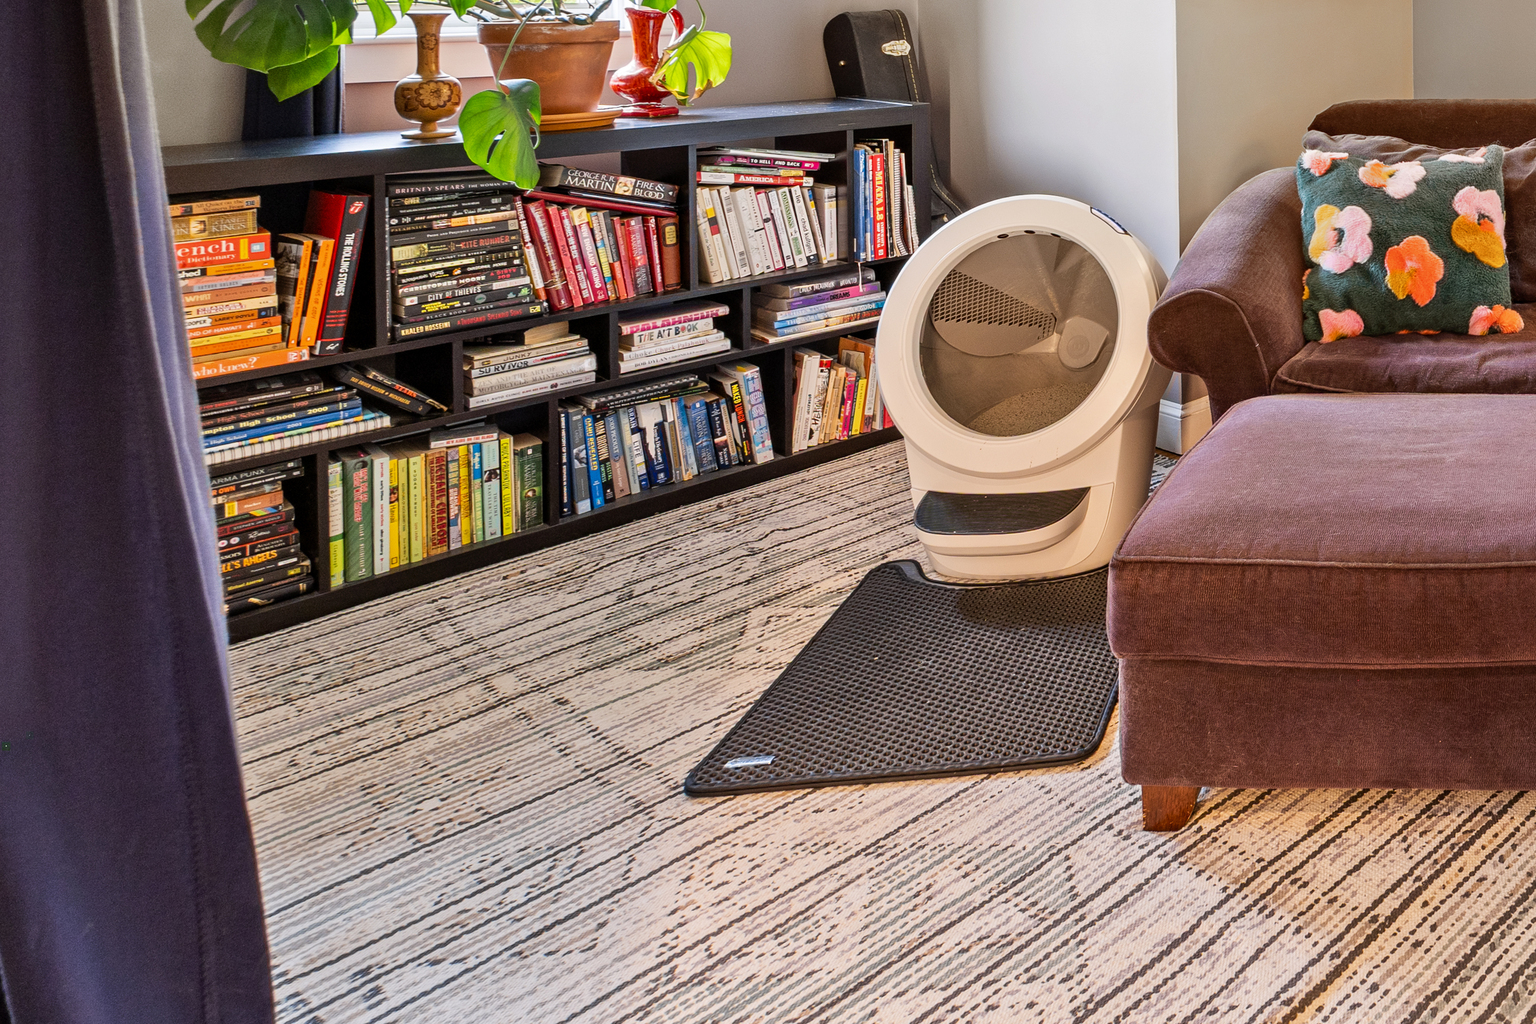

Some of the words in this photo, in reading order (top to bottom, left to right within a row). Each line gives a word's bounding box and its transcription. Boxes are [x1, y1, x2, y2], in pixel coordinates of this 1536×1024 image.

[567, 169, 603, 180] GEORGE
[738, 175, 774, 183] AMERICA
[395, 186, 433, 194] BRITNEY
[565, 176, 614, 191] MARTIN
[635, 180, 654, 190] FIRE
[655, 183, 665, 192] &
[875, 171, 883, 206] MIATA
[634, 188, 664, 200] BLOOD
[515, 201, 526, 221] EXTREME
[781, 191, 795, 229] ADMISSIONS
[520, 220, 531, 243] BREWING
[562, 218, 574, 237] MICHAEL
[579, 224, 589, 238] NEW
[800, 217, 809, 233] chad
[344, 232, 355, 247] THE
[461, 240, 479, 248] KITE
[479, 235, 511, 246] RUNNER
[630, 234, 639, 257] MARTIN
[803, 232, 814, 255] kultgen
[175, 239, 235, 259] ench
[543, 242, 554, 257] CODE
[560, 244, 568, 258] PULP
[569, 244, 580, 259] BLACK
[583, 238, 596, 266] ENGLAND
[187, 251, 236, 265] Dictionary
[339, 245, 352, 273] ROLLING
[548, 259, 557, 271] DAN
[575, 263, 583, 272] MY
[334, 272, 347, 298] STONES
[402, 280, 458, 293] CHRISTOPHER
[459, 276, 486, 284] MOORE
[577, 271, 588, 290] CUSTOM
[590, 266, 603, 289] HIKING
[315, 277, 324, 297] VISIONS
[427, 292, 443, 301] CITY
[454, 286, 482, 296] THIEVES
[581, 289, 590, 298] VAN
[184, 293, 212, 303] WHAT
[829, 291, 851, 301] DREAMS
[400, 326, 424, 336] KHALED
[424, 321, 452, 332] HOSSEINI
[461, 315, 486, 325] THOUSAND
[487, 310, 510, 320] SPLENDID
[637, 332, 655, 344] THE
[655, 328, 674, 339] ART
[673, 322, 700, 336] BOOK
[502, 351, 533, 362] JUNKY
[628, 349, 653, 361] Choke
[654, 344, 677, 355] Chuck
[648, 356, 668, 365] DYLAN
[192, 365, 217, 378] who
[218, 356, 258, 373] knew?
[477, 377, 529, 394] MOTORCYCLE
[478, 379, 494, 388] ZEN
[495, 375, 511, 384] AND
[512, 372, 528, 380] THE
[530, 368, 545, 376] ART
[730, 383, 742, 405] NAKED
[217, 415, 237, 424] High
[239, 409, 265, 420] School
[239, 419, 261, 429] High
[265, 412, 297, 423] School
[306, 406, 329, 415] 2000
[734, 403, 746, 424] LUNCH
[584, 418, 594, 438] OAHU
[594, 420, 606, 436] DAN
[608, 416, 617, 431] JODI
[210, 437, 225, 446] High
[225, 433, 248, 442] School
[626, 407, 638, 429] BRAIN
[632, 440, 642, 459] LIFE
[501, 442, 509, 459] CHUCK
[596, 434, 610, 461] BROWN
[611, 431, 619, 454] PICOULT
[587, 437, 598, 471] REVEALED
[654, 441, 665, 463] Dictionary
[239, 468, 265, 479] PUNX
[435, 456, 446, 500] MICHAEL
[218, 485, 237, 495] OWN
[353, 488, 362, 501] WITH
[503, 493, 511, 518] LULLABY
[436, 502, 447, 546] CHABON
[241, 550, 279, 567] ANGELS
